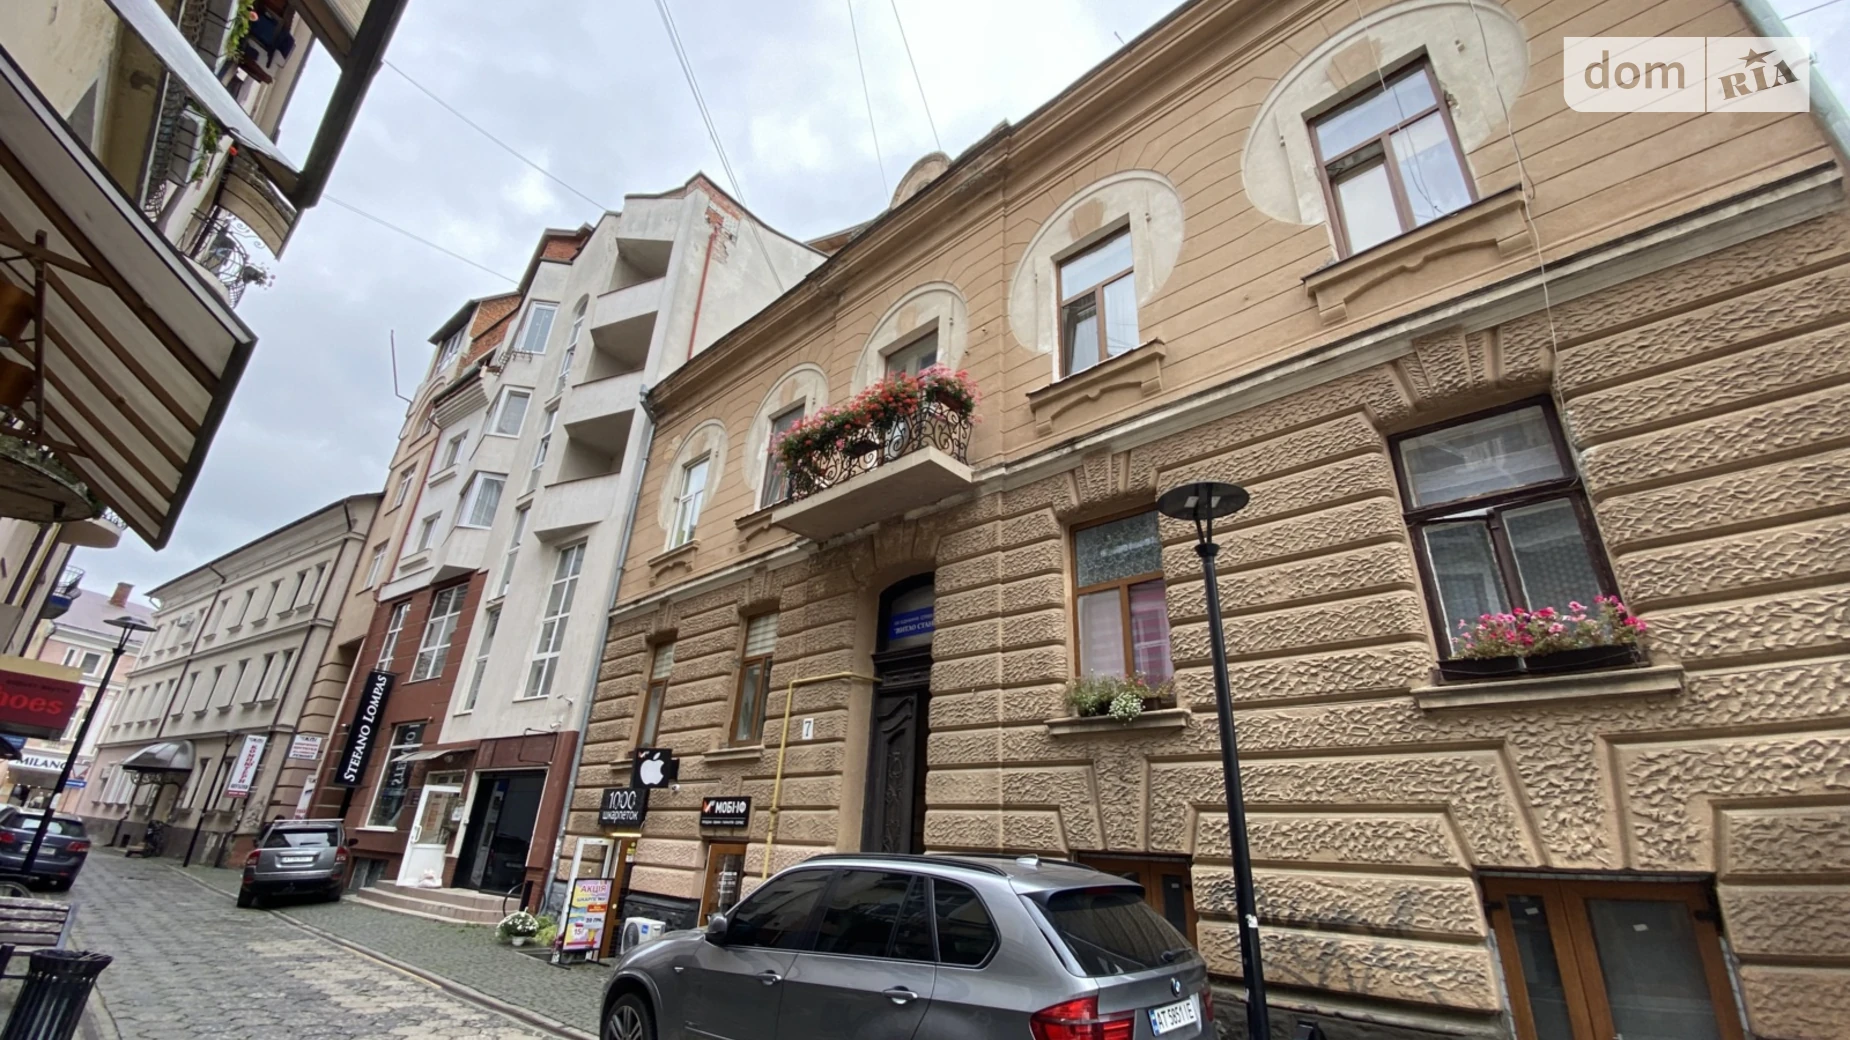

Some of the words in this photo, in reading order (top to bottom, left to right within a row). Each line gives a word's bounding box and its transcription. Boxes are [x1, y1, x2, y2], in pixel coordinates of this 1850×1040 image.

[344, 724, 371, 782] STEFANO
[363, 674, 388, 724] LOMPAS
[805, 721, 812, 736] 7
[609, 790, 637, 810] 1000
[580, 885, 607, 894] АКЦІЯ
[1157, 1010, 1168, 1029] AT
